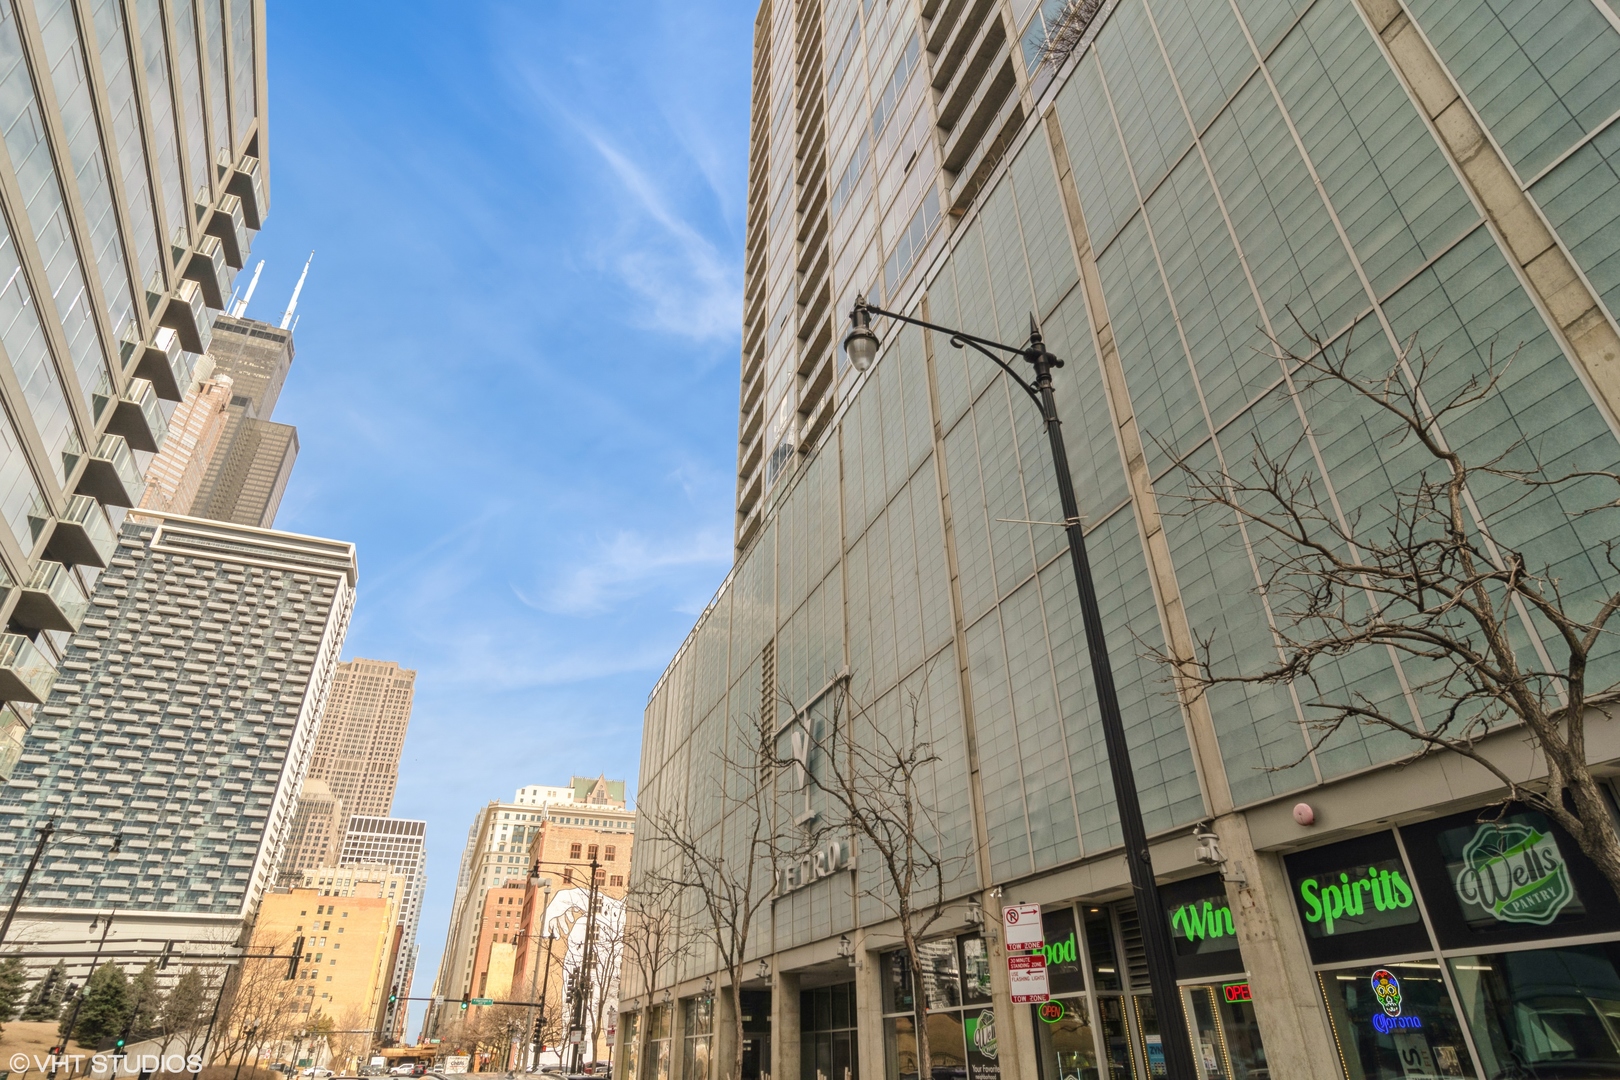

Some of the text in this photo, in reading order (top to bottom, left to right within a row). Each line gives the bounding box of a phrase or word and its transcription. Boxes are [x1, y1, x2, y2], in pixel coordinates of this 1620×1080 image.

[1458, 843, 1558, 909] Wells
[1301, 866, 1413, 935] Spirits
[1511, 886, 1558, 912] PANTRY
[1024, 941, 1041, 949] ZONE
[1029, 994, 1047, 1002] ZONE
[1041, 1005, 1061, 1018] OPEN
[1372, 1013, 1422, 1034] Corona
[971, 1064, 1001, 1073] Your Favorite
